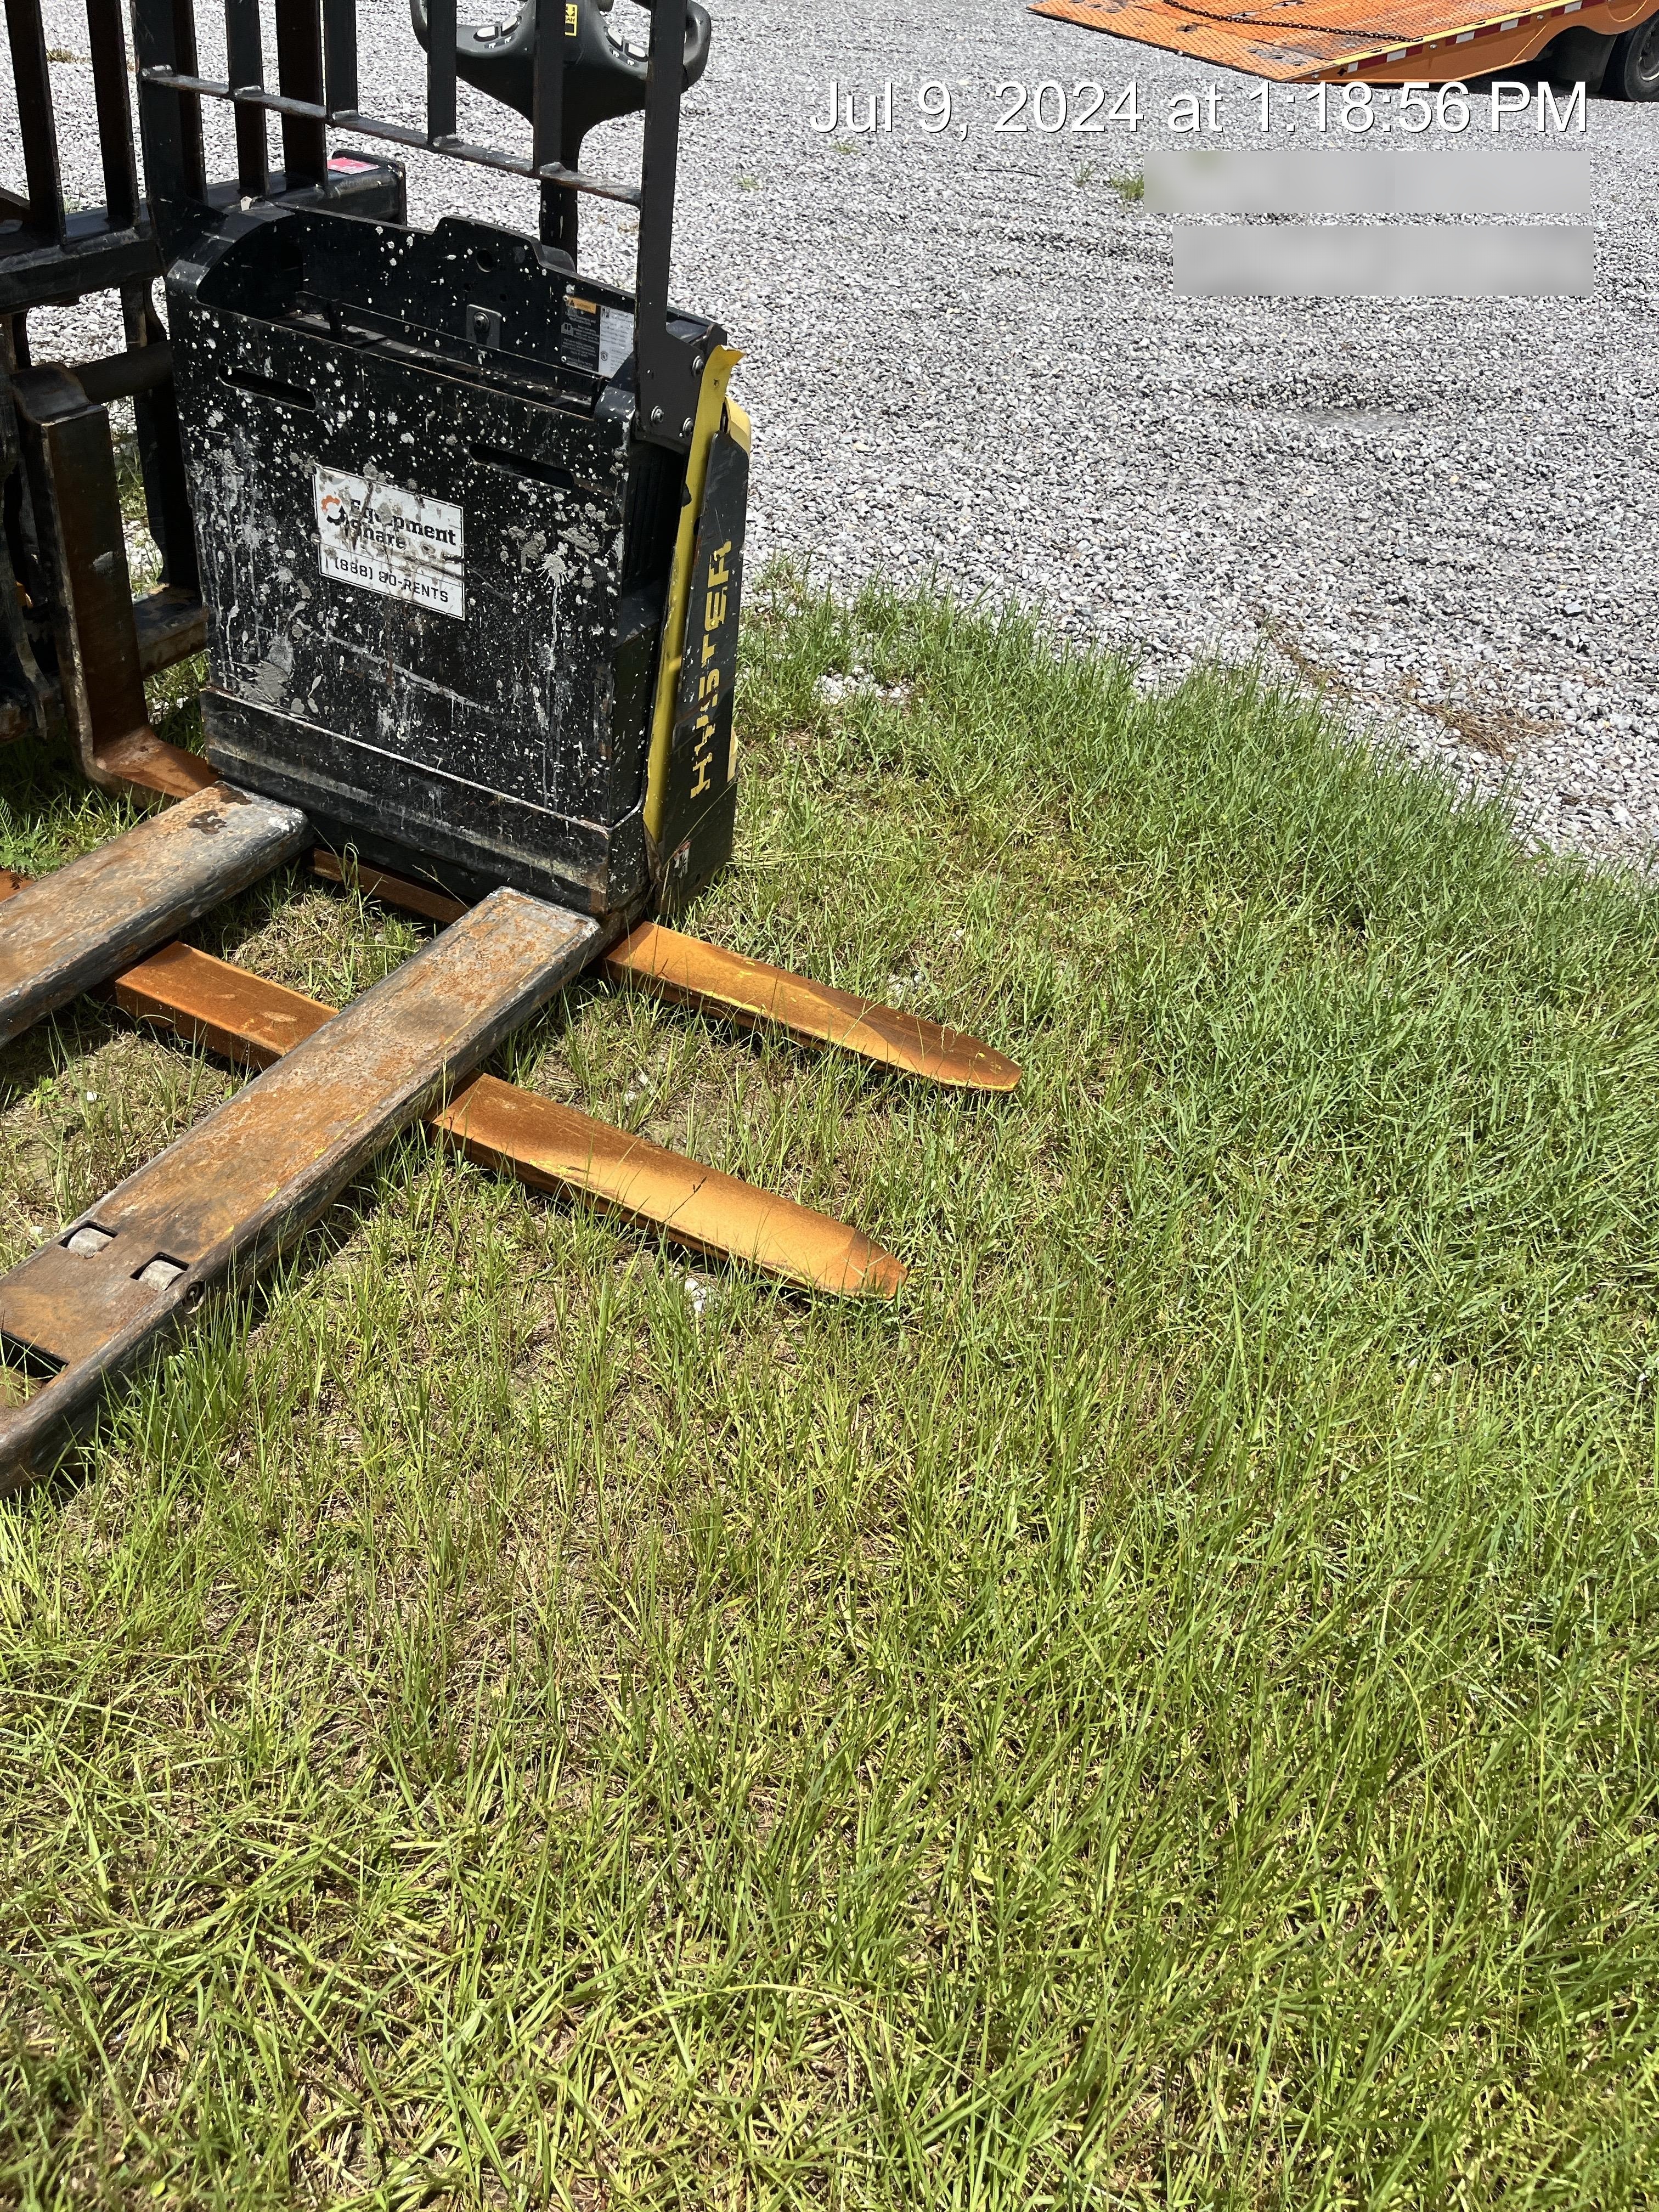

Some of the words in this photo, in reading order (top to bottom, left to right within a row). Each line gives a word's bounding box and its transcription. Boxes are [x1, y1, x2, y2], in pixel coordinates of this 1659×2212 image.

[350, 498, 456, 546] Eqpment
[335, 556, 373, 580] (888)
[690, 540, 732, 799] HYSTER
